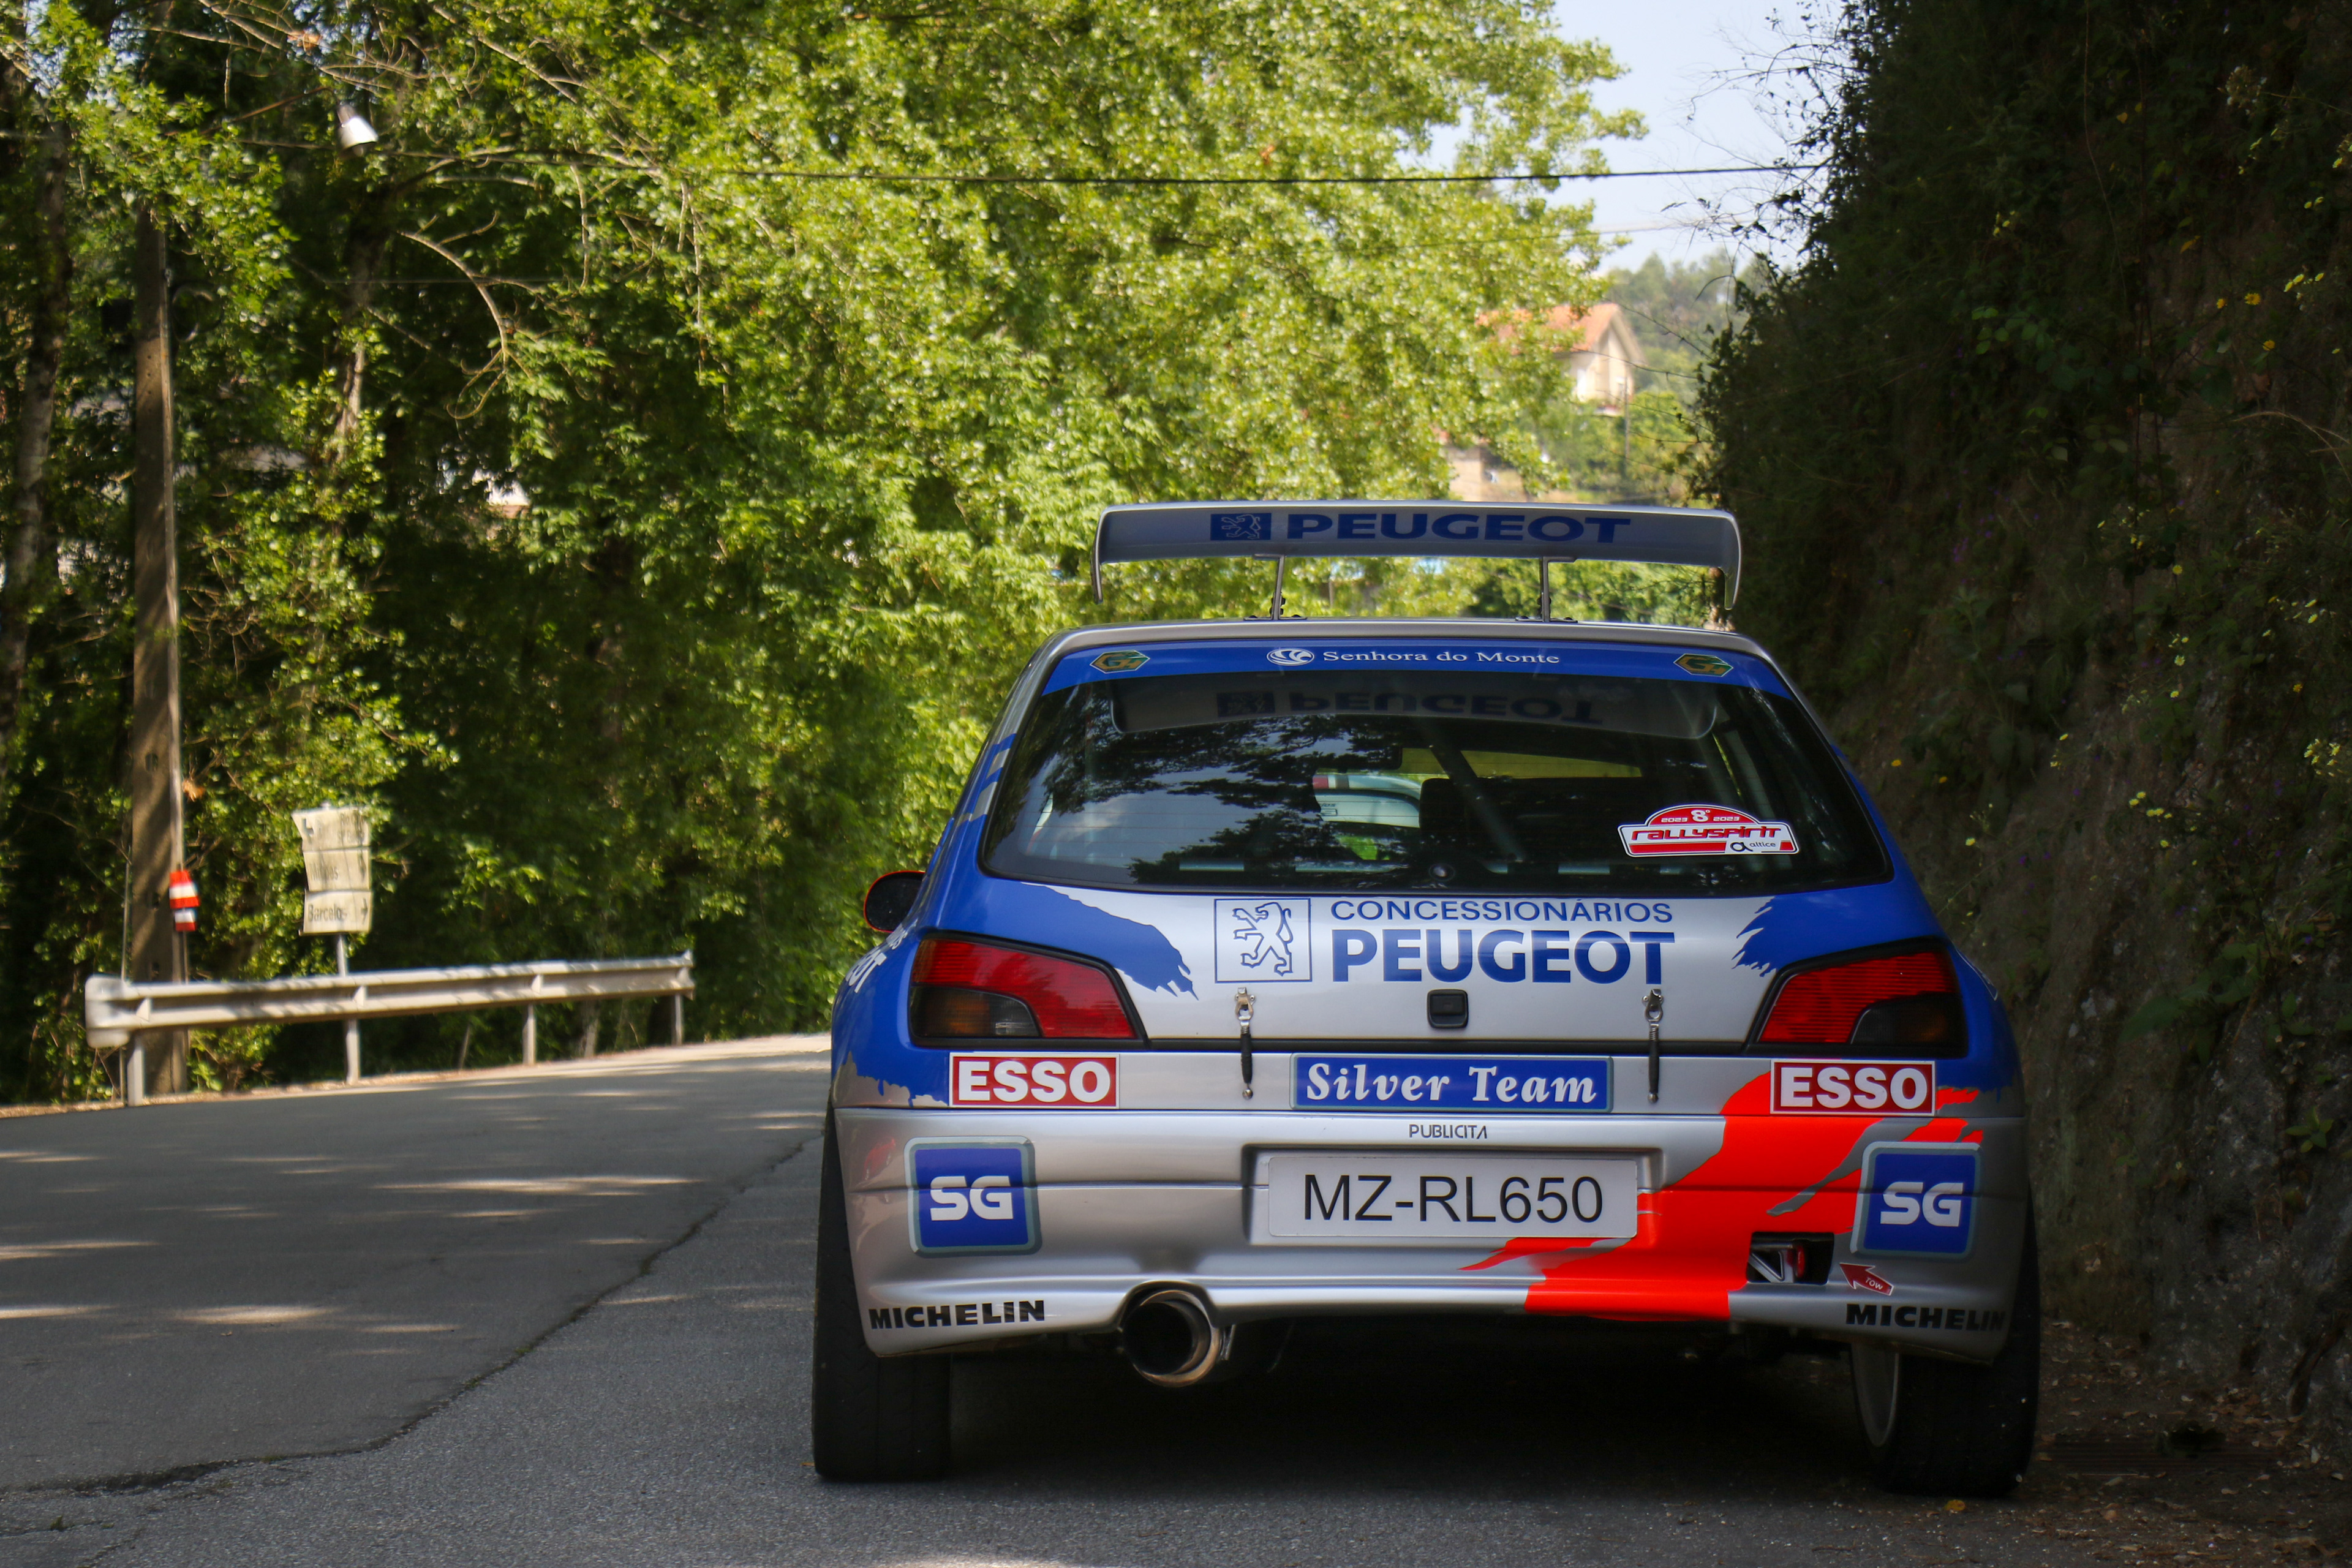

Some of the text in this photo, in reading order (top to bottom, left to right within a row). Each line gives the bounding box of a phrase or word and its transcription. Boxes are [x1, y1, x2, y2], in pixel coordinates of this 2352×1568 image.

[1287, 513, 1630, 543] PEUGEOT
[1323, 651, 1559, 663] Senhora do Monte
[307, 904, 348, 922] Barcelos
[1330, 898, 1673, 923] CONCESSIONÁRIOS
[1332, 929, 1675, 985] PEUGEOT
[958, 1060, 1111, 1103] ESSO
[1306, 1063, 1597, 1103] Silver Team
[1780, 1067, 1928, 1110] ESSO
[930, 1175, 1014, 1221] SG
[1303, 1174, 1603, 1223] MZ-RL650
[1880, 1182, 1963, 1227] SG
[1865, 1277, 1883, 1291] TOW
[869, 1300, 1045, 1330] MICHELIN
[1845, 1303, 2006, 1331] MICHELIN
